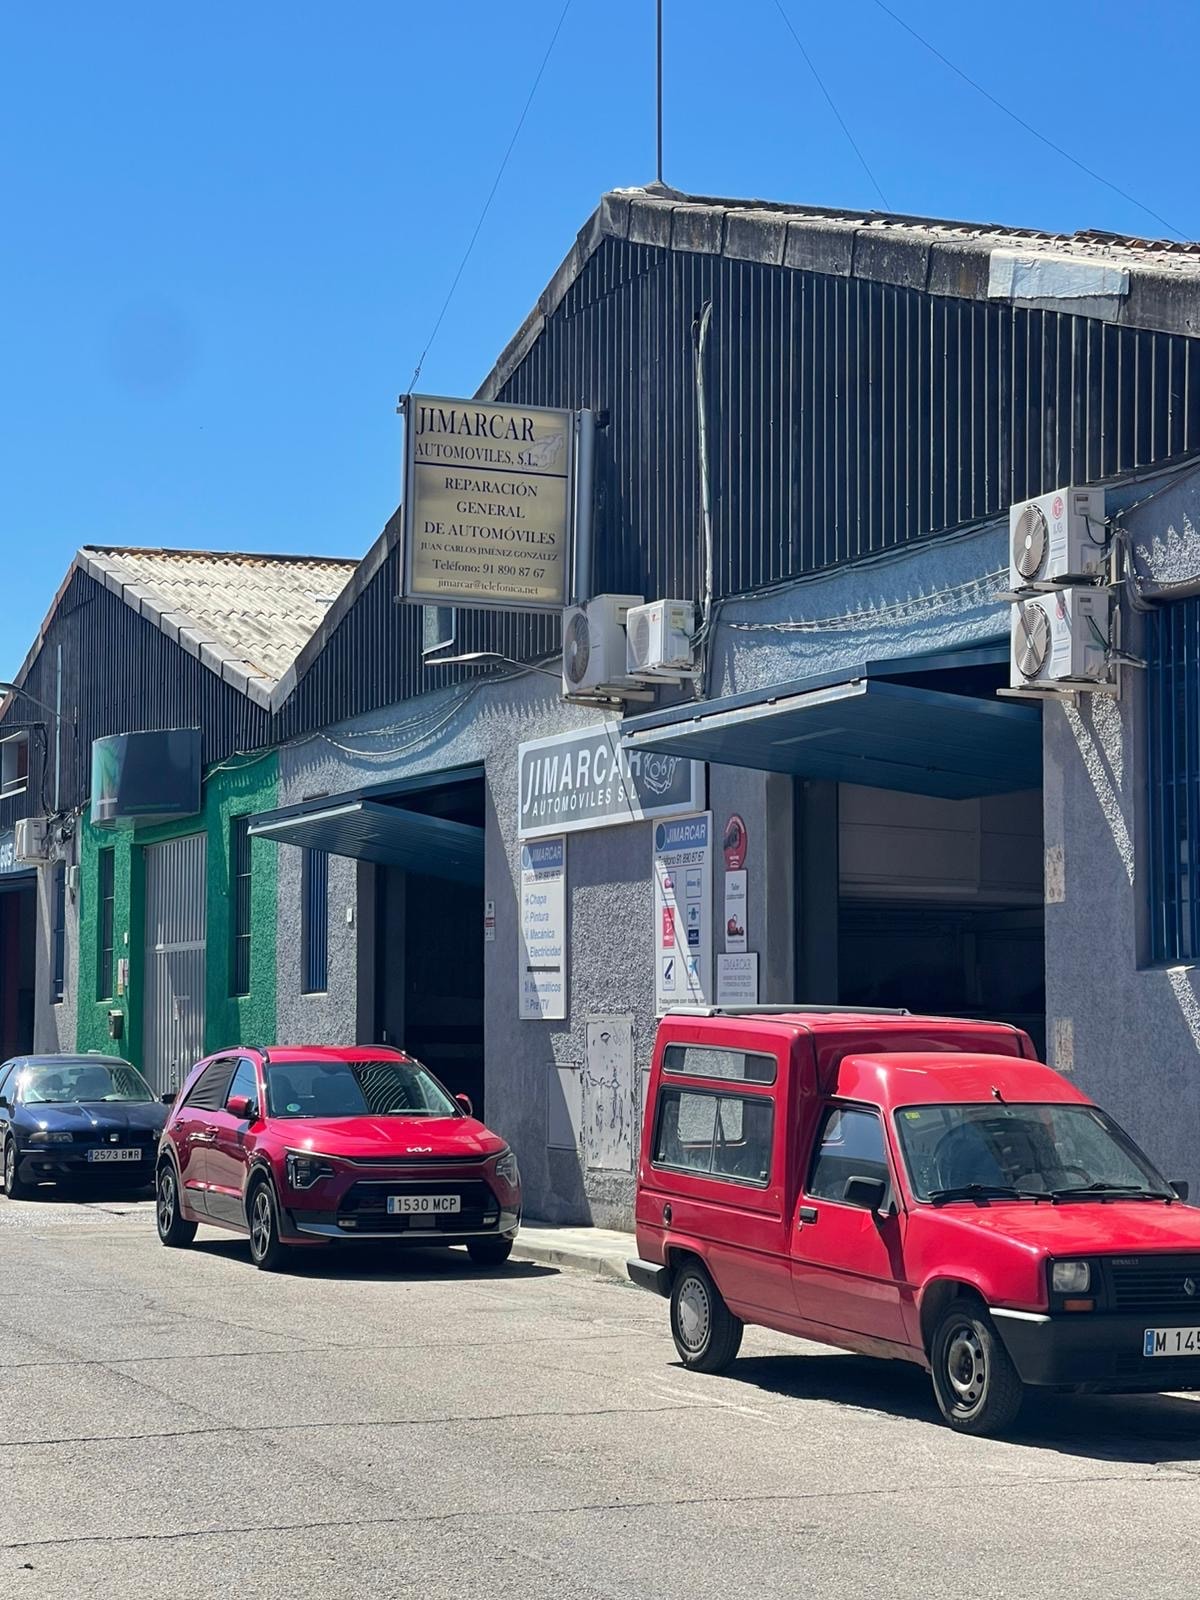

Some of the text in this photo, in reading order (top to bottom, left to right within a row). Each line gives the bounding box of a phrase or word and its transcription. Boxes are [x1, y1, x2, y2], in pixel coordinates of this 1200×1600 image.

[415, 407, 535, 441] JIMARCAR
[517, 453, 538, 467] S.L.
[445, 477, 538, 497] REPARACIÓN
[456, 500, 526, 518] GENERAL
[424, 521, 556, 545] DE AUTOMÓVILES
[421, 541, 442, 551] JUAN
[444, 544, 477, 555] CARLOS
[432, 559, 546, 579] Teléfono: 91 890 87 67
[523, 743, 640, 814] JIMARCAR
[532, 787, 612, 817] AUTOMÓVILES
[666, 824, 706, 844] JIMARCAR
[94, 1150, 119, 1160] 2573
[398, 1198, 457, 1211] 1530 MCP
[1156, 1332, 1166, 1352] M
